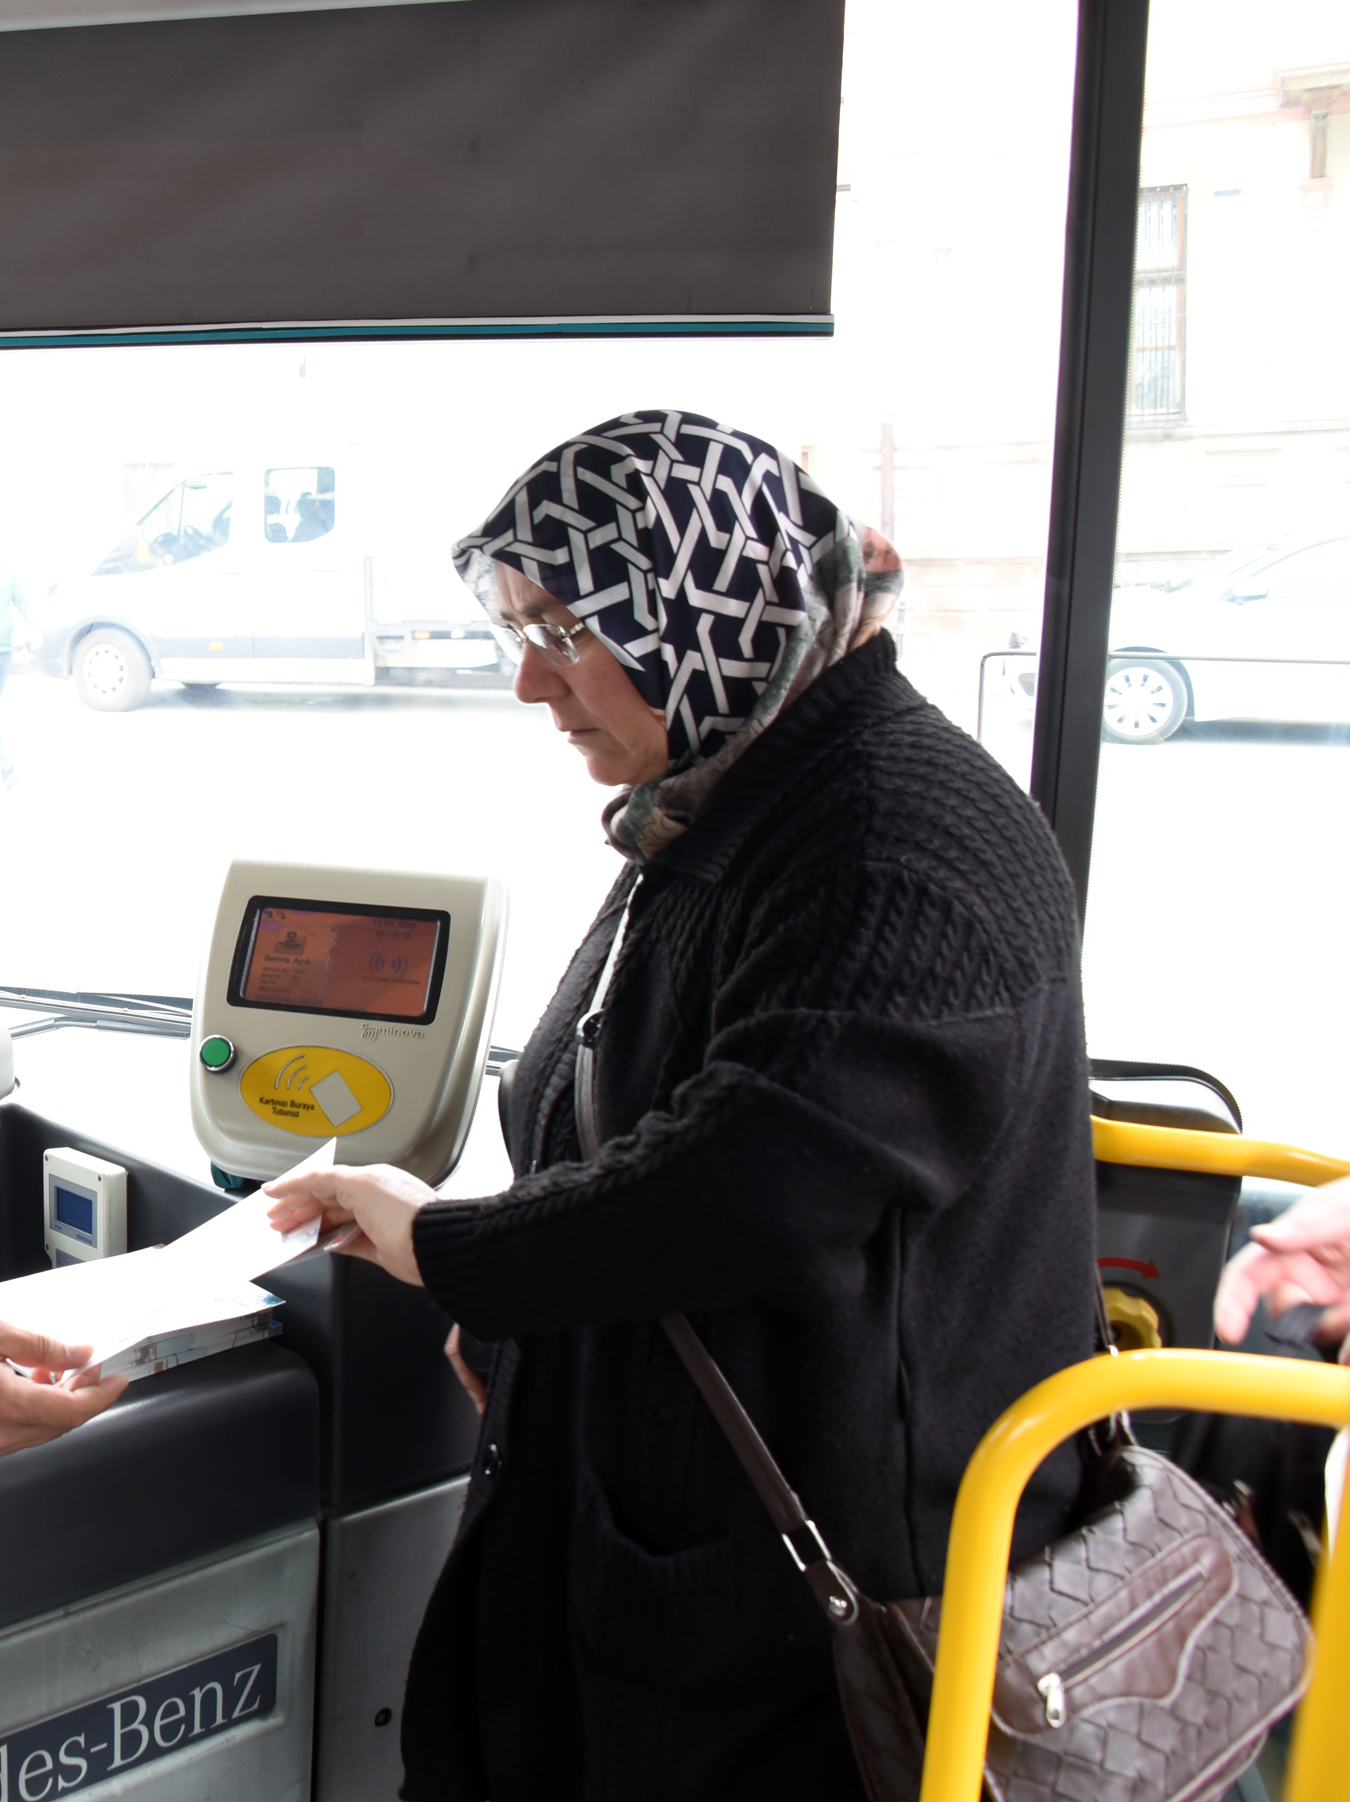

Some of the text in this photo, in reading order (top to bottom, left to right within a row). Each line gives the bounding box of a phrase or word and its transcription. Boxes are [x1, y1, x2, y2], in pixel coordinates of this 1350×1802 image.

[264, 954, 290, 964] Servis
[259, 1096, 315, 1111] Kartınızı Buraya
[272, 1106, 300, 1118] Tutunuz
